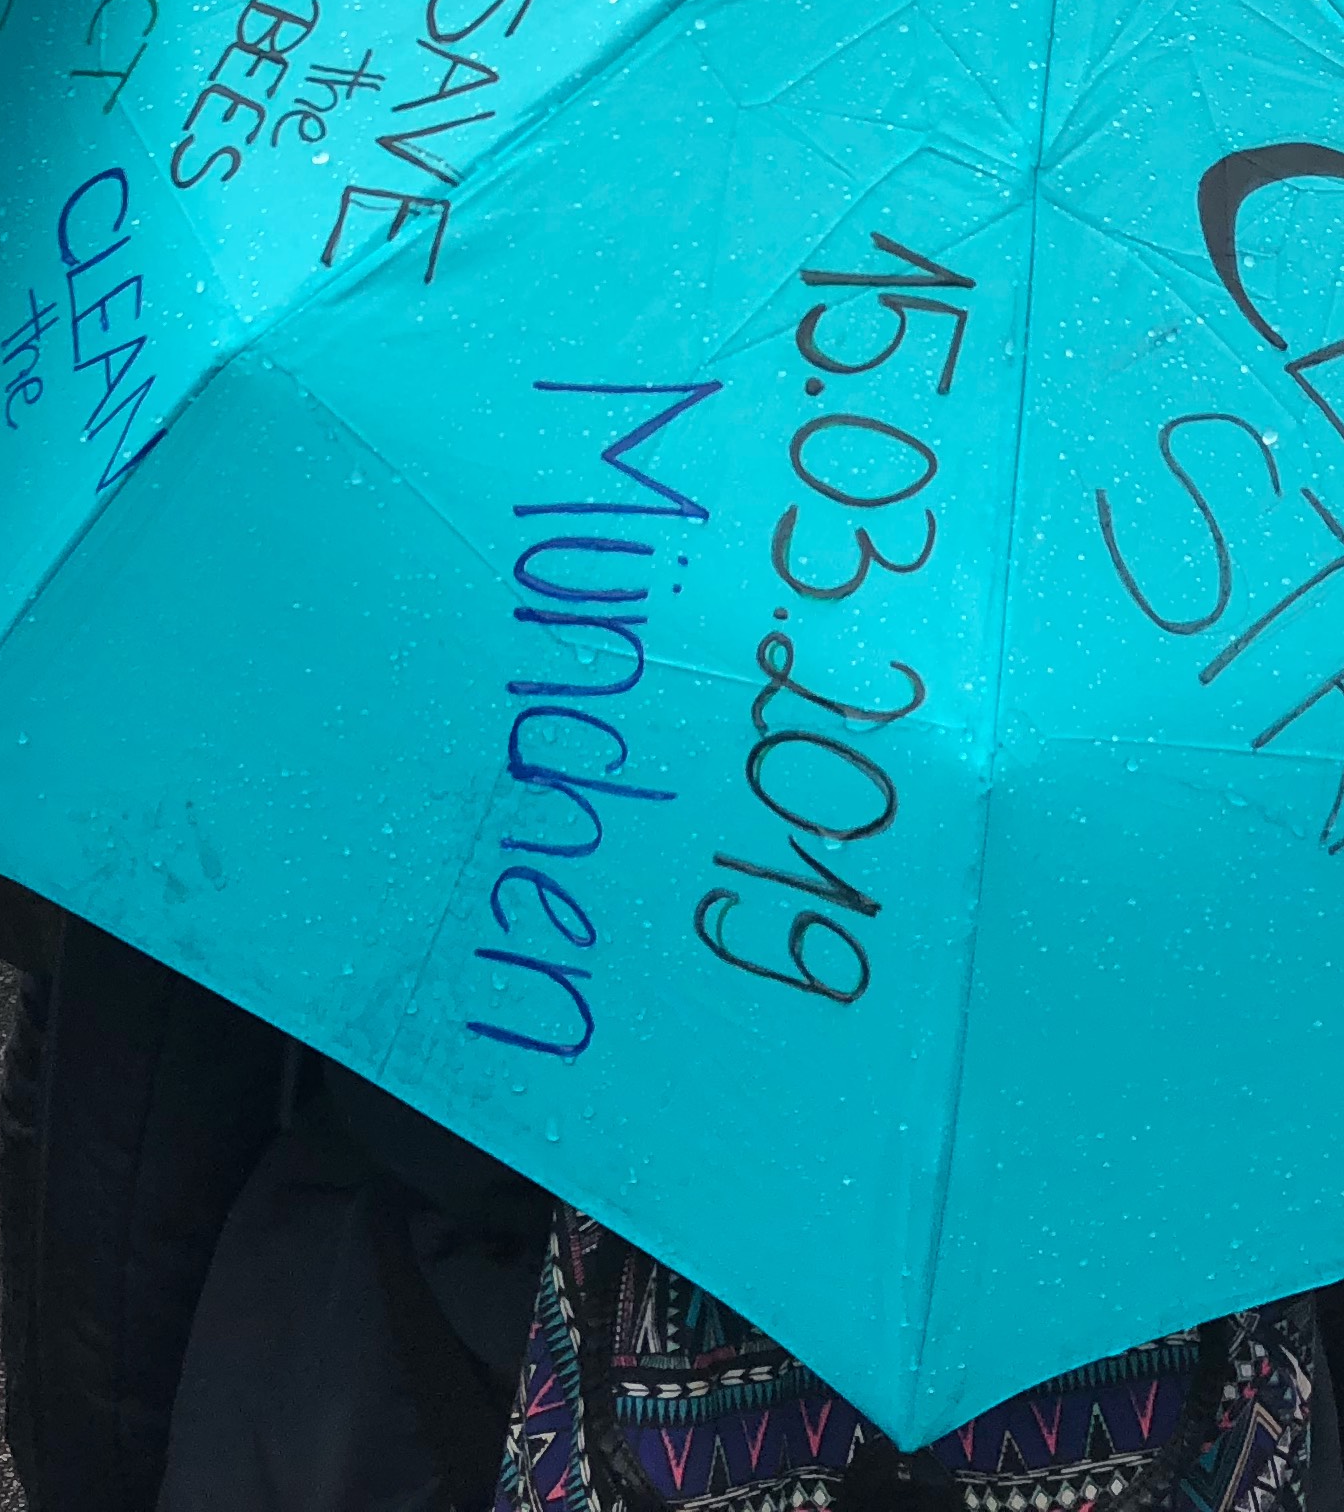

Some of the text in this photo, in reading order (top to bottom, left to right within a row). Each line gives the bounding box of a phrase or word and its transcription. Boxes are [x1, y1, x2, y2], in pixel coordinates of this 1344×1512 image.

[271, 46, 387, 149] the
[0, 287, 60, 431] the
[57, 166, 169, 496] CLEAN
[464, 379, 724, 1059] München
[693, 231, 978, 1007] 15.03.2019
